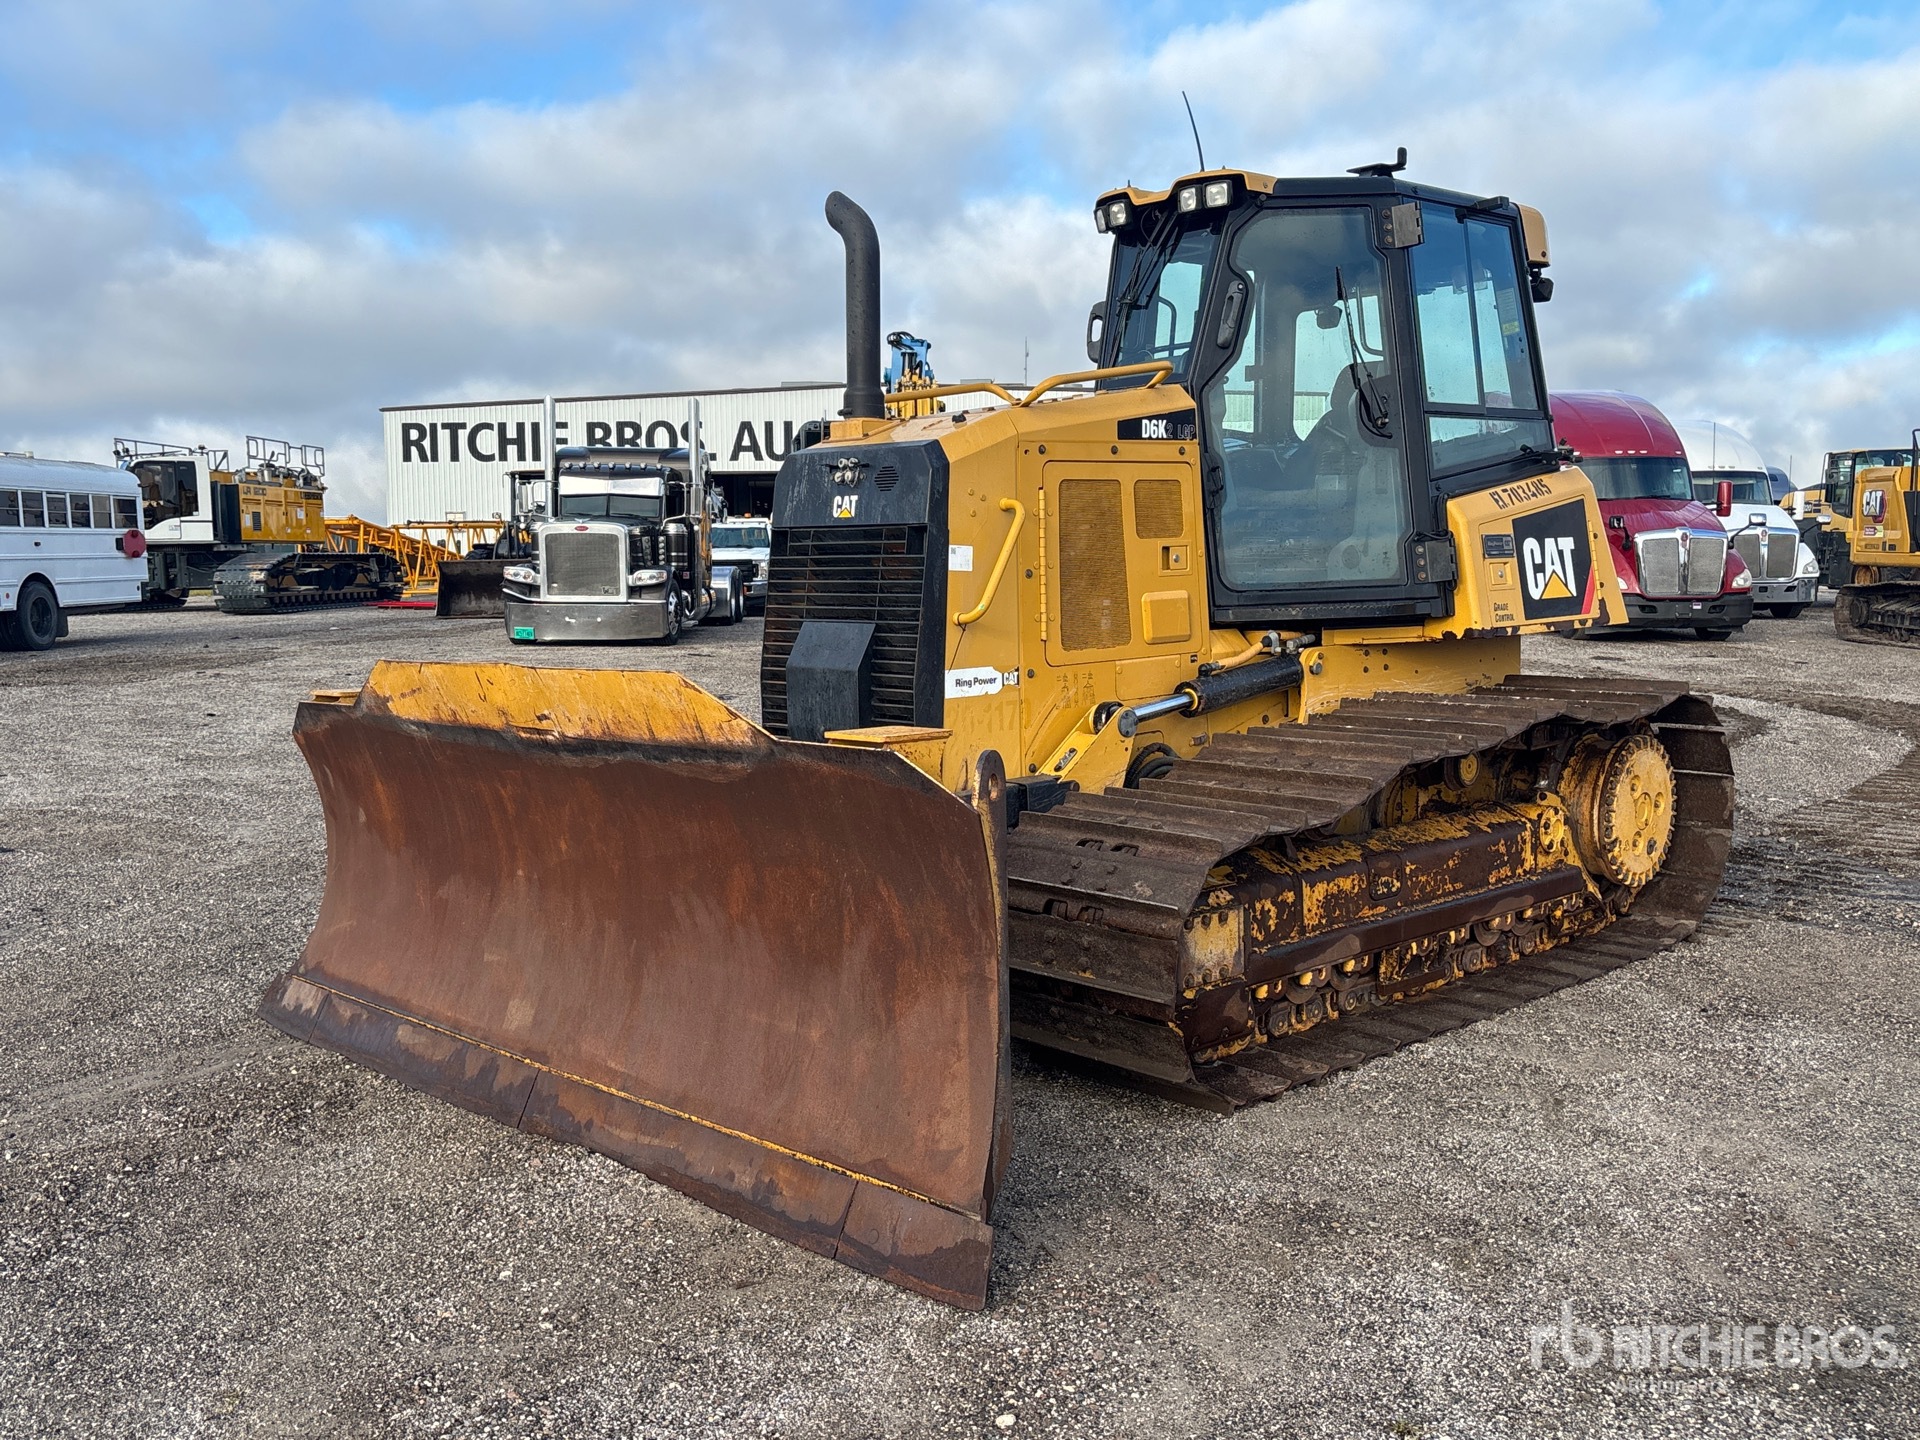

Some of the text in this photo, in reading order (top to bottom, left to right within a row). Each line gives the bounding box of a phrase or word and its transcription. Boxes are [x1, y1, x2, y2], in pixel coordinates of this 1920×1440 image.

[1178, 424, 1196, 440] LGP
[832, 494, 859, 519] CAT
[1863, 490, 1882, 516] CAT
[1522, 536, 1577, 600] CAT
[955, 676, 998, 689] Ring Power
[1003, 672, 1019, 686] CAT
